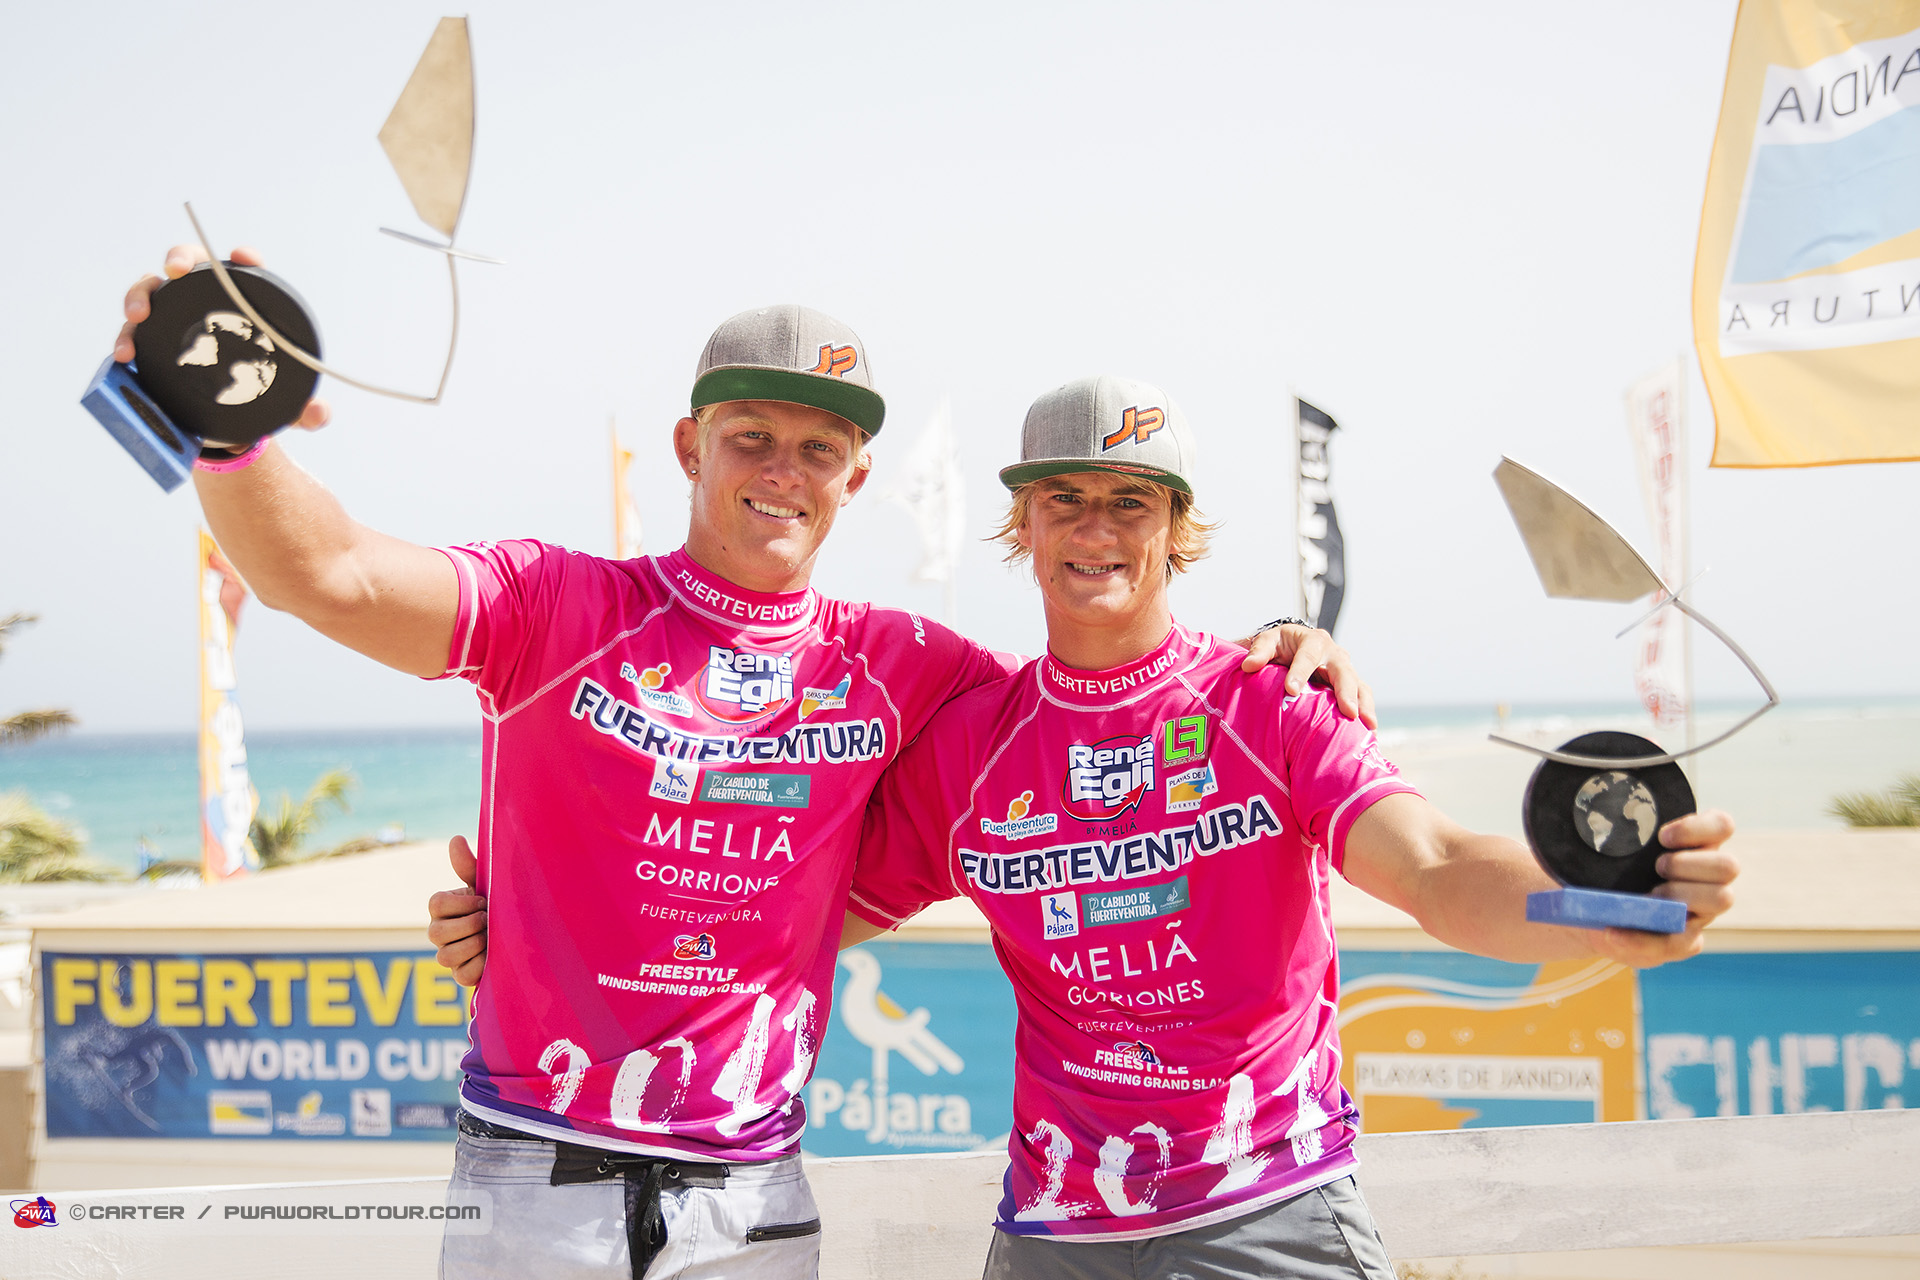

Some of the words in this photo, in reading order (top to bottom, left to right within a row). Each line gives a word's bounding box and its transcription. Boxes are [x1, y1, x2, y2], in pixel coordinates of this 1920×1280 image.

[803, 345, 857, 377] JP
[1102, 406, 1164, 451] JP
[709, 646, 794, 673] René
[1048, 648, 1180, 694] FUERTEVENTURA
[706, 666, 794, 713] Egli
[574, 682, 884, 762] FUERTEVENTURA
[1068, 735, 1154, 768] René
[722, 777, 757, 790] CABILDO
[759, 778, 769, 789] DE
[1070, 759, 1154, 807] Egli
[1192, 771, 1201, 779] DE
[653, 782, 688, 800] Pájara
[707, 788, 773, 803] FUERTEVENTURA
[982, 815, 1055, 833] Fuerteventura
[961, 801, 1278, 888] FUERTEVENTURA
[1090, 903, 1157, 923] FUERTEVENTURA
[1101, 894, 1137, 909] CABILDO
[1139, 892, 1151, 904] DE
[1047, 923, 1074, 936] Pájara
[680, 942, 708, 953] PWA
[598, 973, 688, 996] WINDSURFING
[690, 984, 731, 997] GRAND
[731, 982, 767, 995] SLAM
[639, 964, 738, 982] FREESTYLE
[52, 957, 474, 1027] FUERTEVE
[204, 1039, 370, 1081] WORLD
[375, 1039, 463, 1081] CUP
[1062, 1060, 1142, 1087] WINDSURFING
[1143, 1077, 1190, 1091] GRAND
[1356, 1063, 1449, 1089] PLAYAS
[1457, 1064, 1490, 1090] DE
[809, 1078, 972, 1144] Pájara
